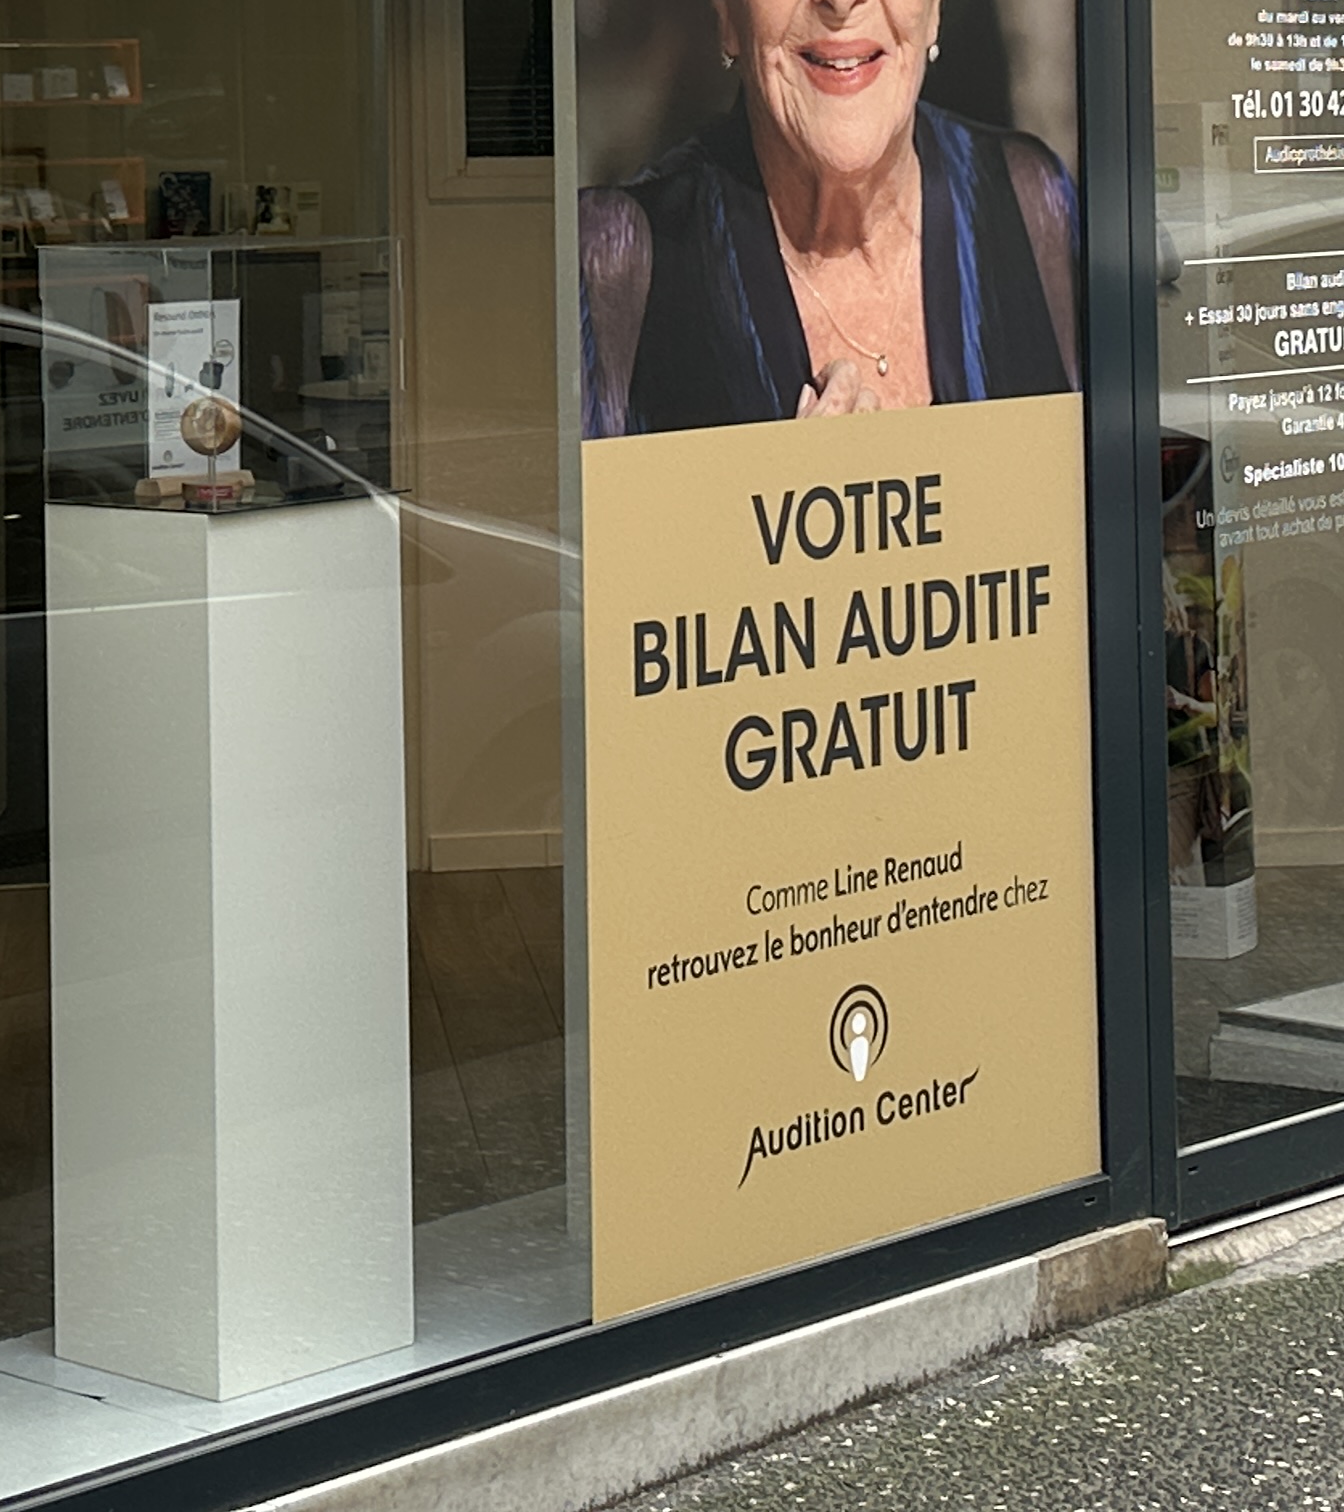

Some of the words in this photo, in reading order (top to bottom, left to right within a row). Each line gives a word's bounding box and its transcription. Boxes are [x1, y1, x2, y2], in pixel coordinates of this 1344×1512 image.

[1258, 9, 1273, 23] du
[1276, 11, 1308, 24] mardi
[1312, 13, 1326, 24] au
[1228, 33, 1243, 46] de
[1245, 33, 1274, 47] 9h30
[1276, 34, 1284, 47] à
[1310, 35, 1321, 47] et
[1323, 35, 1338, 47] de
[1251, 57, 1262, 70] le
[1264, 58, 1306, 71] samedi
[1309, 57, 1323, 71] de
[1231, 90, 1267, 119] Tél.
[1270, 90, 1293, 118] 01
[1299, 90, 1324, 117] 30
[1286, 272, 1318, 290] Bilan
[1199, 306, 1234, 325] Essai
[1237, 304, 1253, 323] 30
[1255, 302, 1288, 325] jours
[1290, 301, 1320, 318] sans
[1229, 392, 1267, 414] Payez
[1269, 385, 1315, 411] jusqu'à
[1317, 385, 1332, 402] 12
[1282, 417, 1335, 435] Garantie
[1337, 415, 1344, 430] 4
[1244, 457, 1325, 487] Spécialiste
[751, 473, 942, 566] VOTRE
[1196, 509, 1215, 529] Un
[1217, 505, 1250, 525] devis
[1252, 495, 1295, 520] détaillé
[1298, 494, 1327, 510] vous
[1219, 526, 1254, 547] avant
[1256, 522, 1280, 542] tout
[1282, 516, 1315, 538] achat
[1318, 514, 1333, 531] de
[633, 596, 816, 697] BILAN
[836, 564, 1050, 665] AUDITIF
[724, 679, 977, 792] GRATUIT
[746, 876, 829, 916] Comme
[834, 866, 879, 897] Line
[884, 841, 963, 885] Renaud
[647, 941, 759, 989] retrouvez
[764, 930, 783, 963] le
[790, 912, 883, 956] bonheur
[887, 884, 999, 934] d'entendre
[1003, 875, 1049, 909] chez
[737, 1107, 865, 1191] Audition
[876, 1064, 981, 1126] Center
